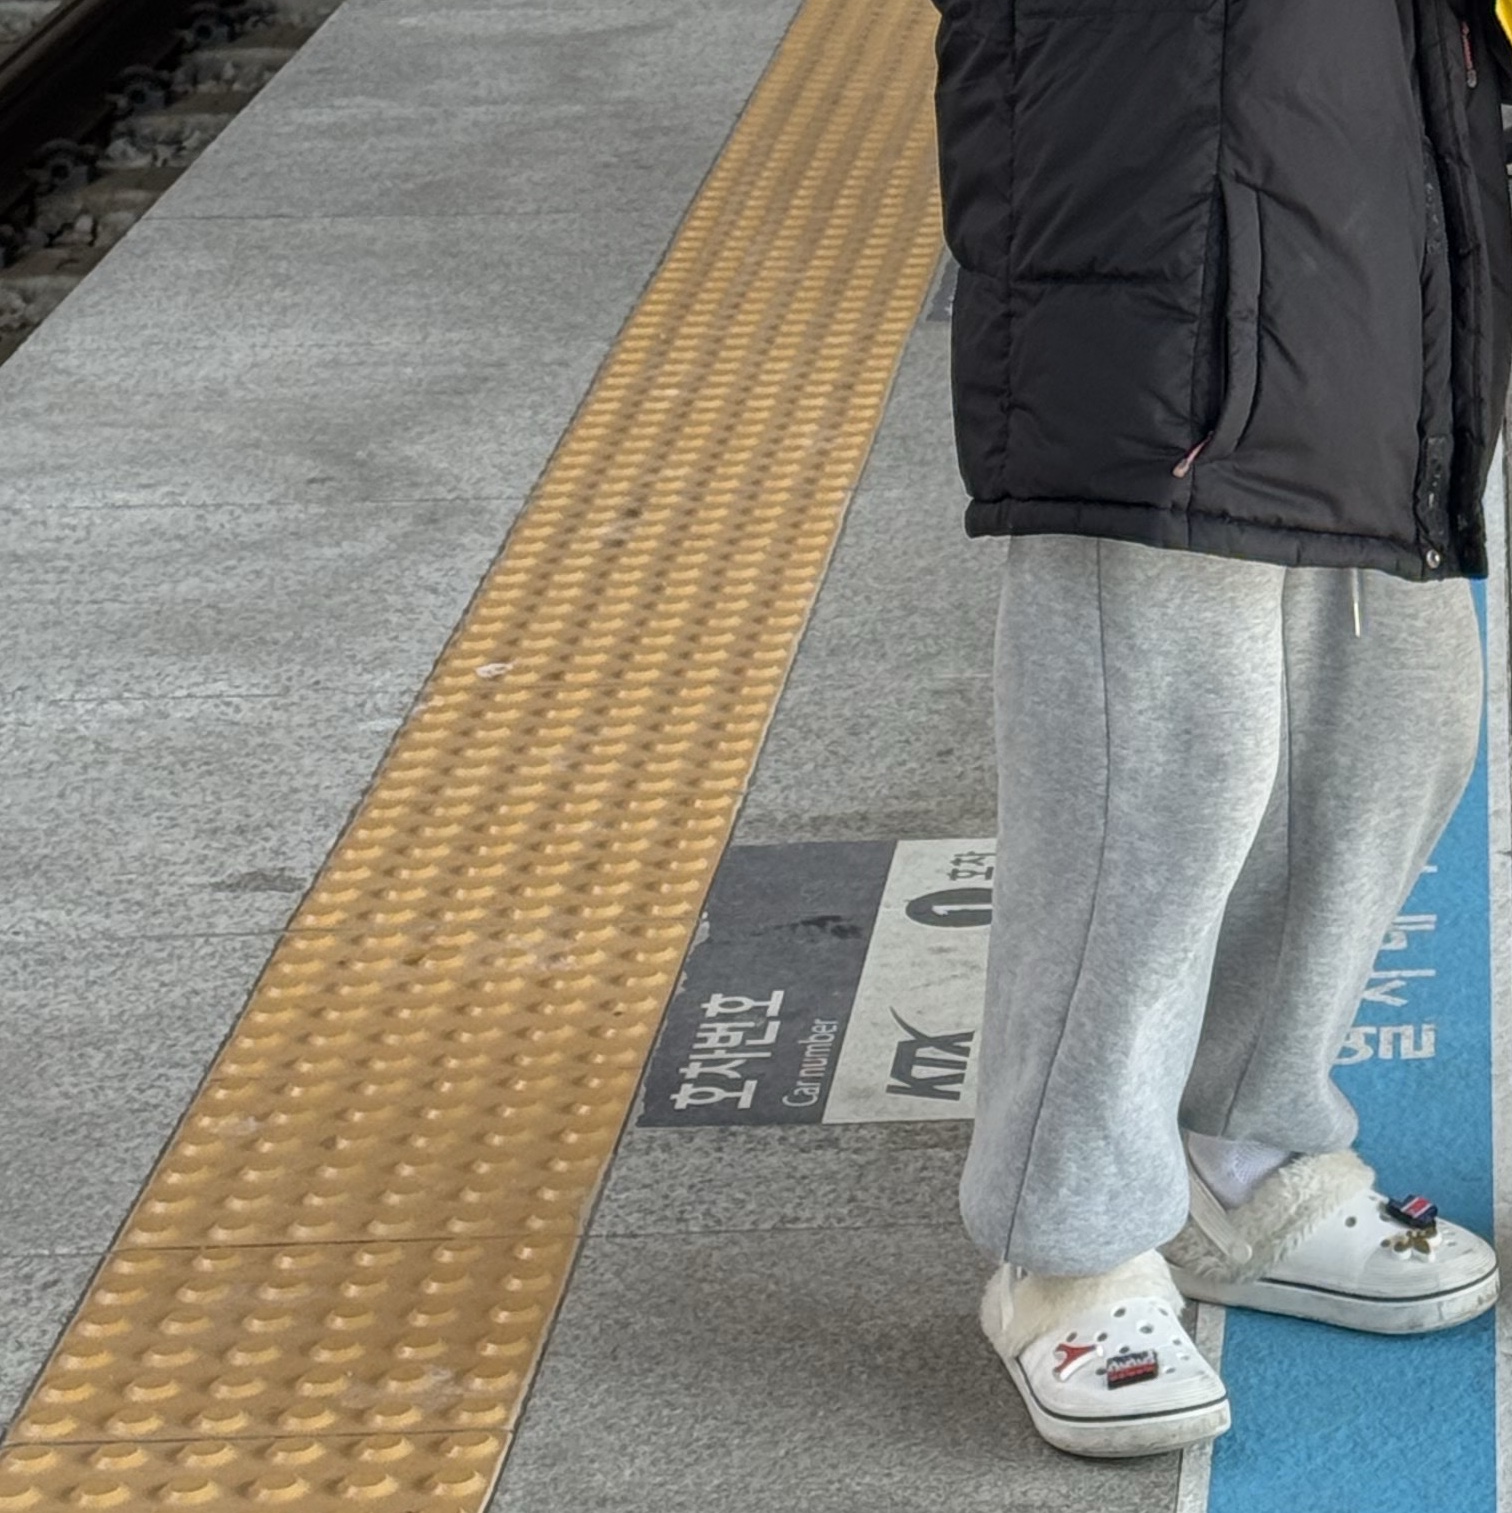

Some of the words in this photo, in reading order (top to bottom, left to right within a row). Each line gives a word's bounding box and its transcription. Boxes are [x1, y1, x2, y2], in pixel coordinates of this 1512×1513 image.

[670, 990, 784, 1109] 호차번호
[798, 1018, 839, 1078] number
[885, 1005, 976, 1101] KTX
[782, 1079, 822, 1107] Car
